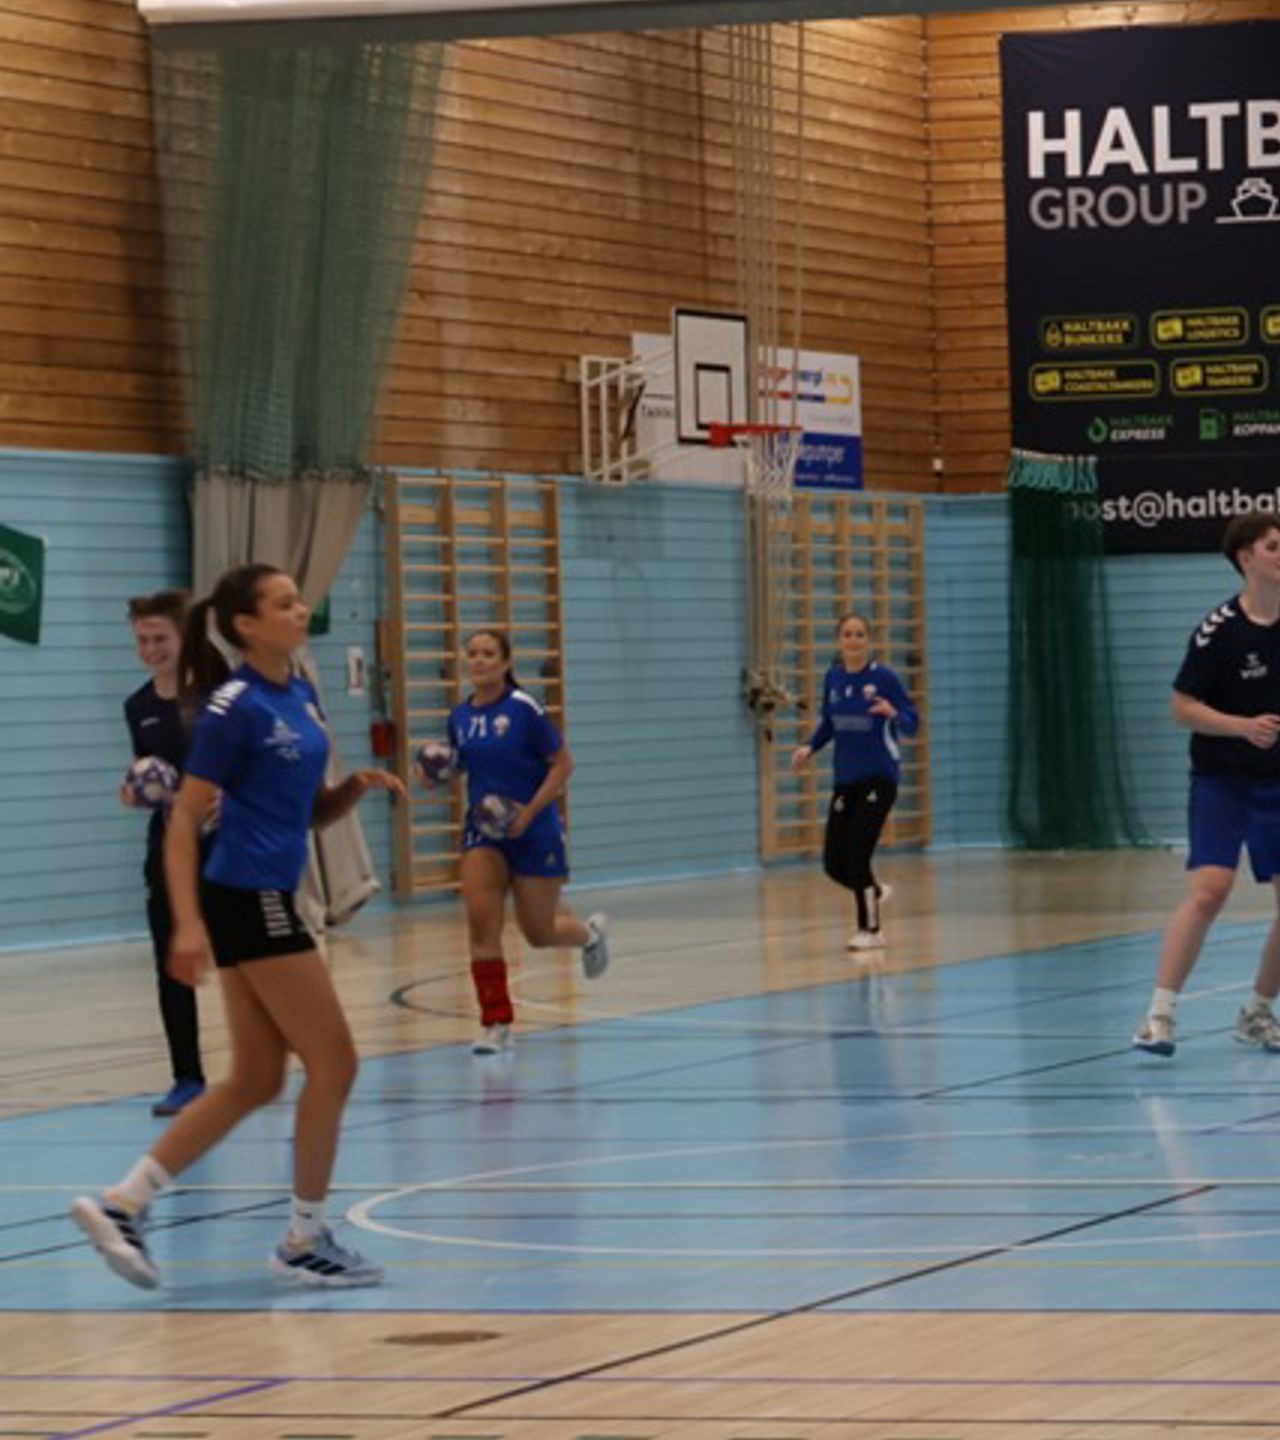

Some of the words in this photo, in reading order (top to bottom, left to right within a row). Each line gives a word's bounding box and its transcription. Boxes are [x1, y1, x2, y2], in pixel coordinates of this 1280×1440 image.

[1030, 181, 1208, 231] GROUP
[1063, 320, 1130, 332] HALTBAKK
[1110, 428, 1166, 441] EXPRESS
[467, 714, 488, 739] 71
